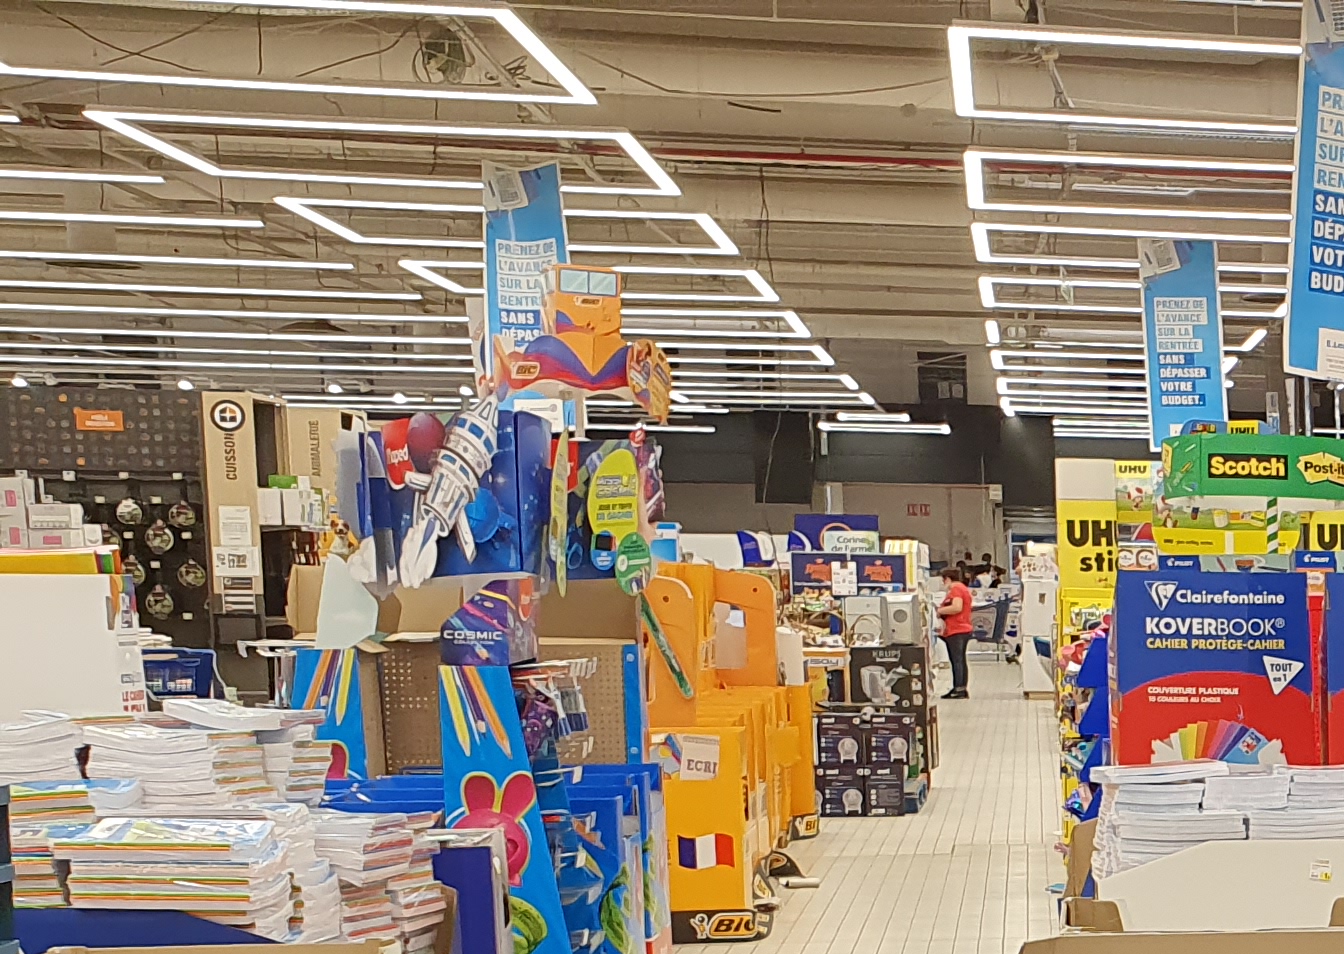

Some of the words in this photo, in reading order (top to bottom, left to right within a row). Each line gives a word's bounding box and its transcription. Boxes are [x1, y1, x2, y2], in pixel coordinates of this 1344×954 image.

[497, 241, 541, 255] PRENEZ
[499, 277, 523, 290] SUR
[499, 294, 542, 307] RENTR
[1156, 299, 1191, 310] PRENEZ
[500, 311, 535, 325] SANS
[1156, 313, 1202, 323] L'AVANCE
[1157, 327, 1176, 337] SUR
[1178, 326, 1191, 336] LA
[1158, 338, 1200, 351] RENTRÉE
[1159, 354, 1185, 365] SANS
[1159, 365, 1207, 378] DÉPASSER
[1160, 381, 1193, 392] VOTRE
[1161, 395, 1204, 406] BUDGET.
[226, 432, 239, 481] CUISSON
[1118, 465, 1147, 475] UHU
[1210, 455, 1286, 478] Scotch
[1066, 519, 1117, 548] UH
[1175, 589, 1285, 605] Clairefontaine
[443, 629, 503, 641] COSMIC
[1146, 638, 1189, 650] CAHIER
[1191, 635, 1285, 651] PROTÈGE-CAHIER
[1269, 662, 1293, 673] TOUT
[1147, 686, 1197, 695] COUVERTURE
[1198, 686, 1239, 696] PLASTIQUE
[687, 759, 717, 774] ECRI
